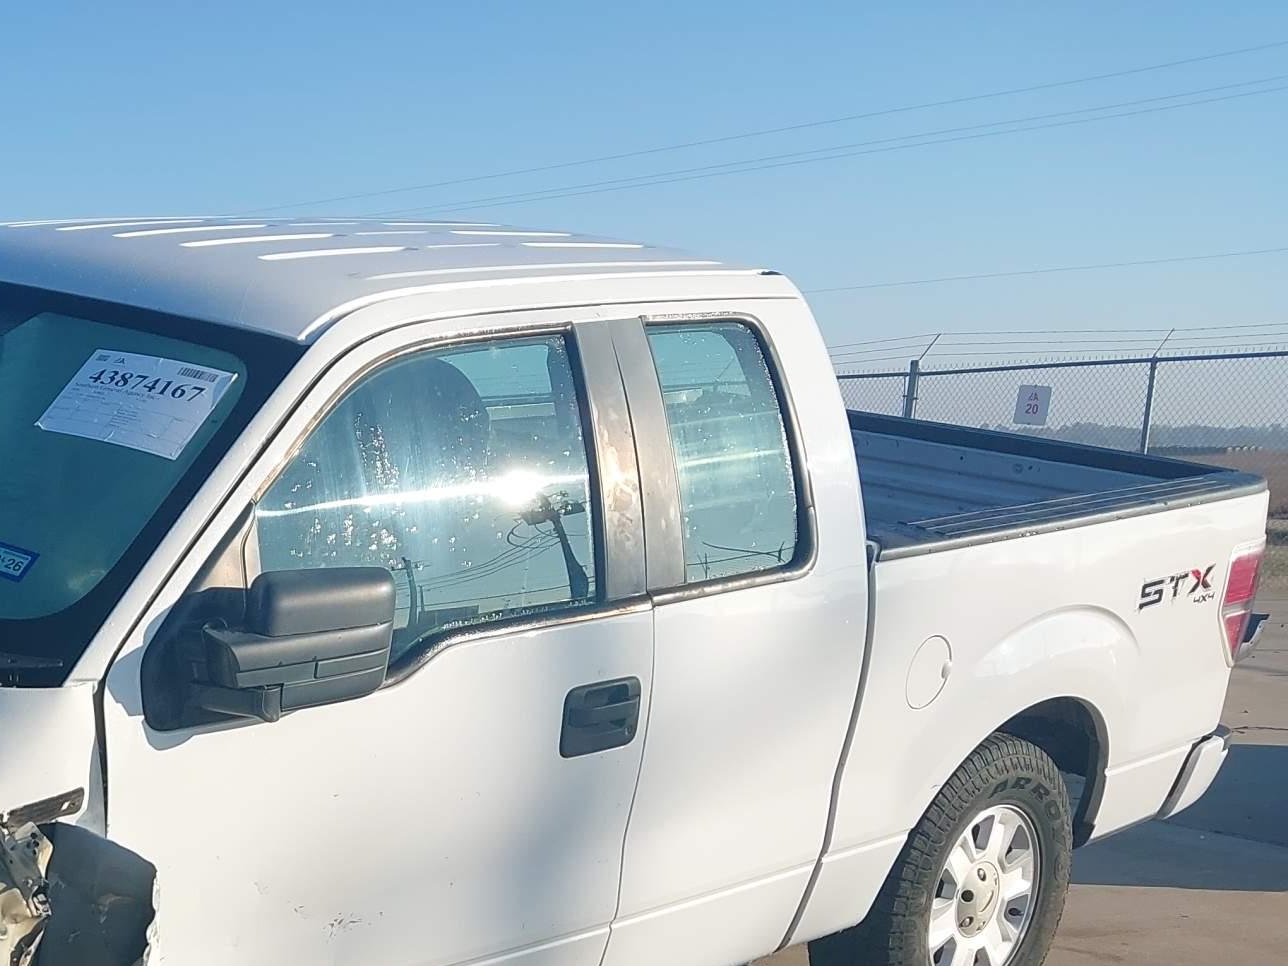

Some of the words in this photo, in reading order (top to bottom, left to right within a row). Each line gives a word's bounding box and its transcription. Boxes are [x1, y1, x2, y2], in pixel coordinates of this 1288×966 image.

[88, 368, 206, 402] 43874167
[1025, 403, 1039, 415] 20
[1138, 562, 1216, 610] STX
